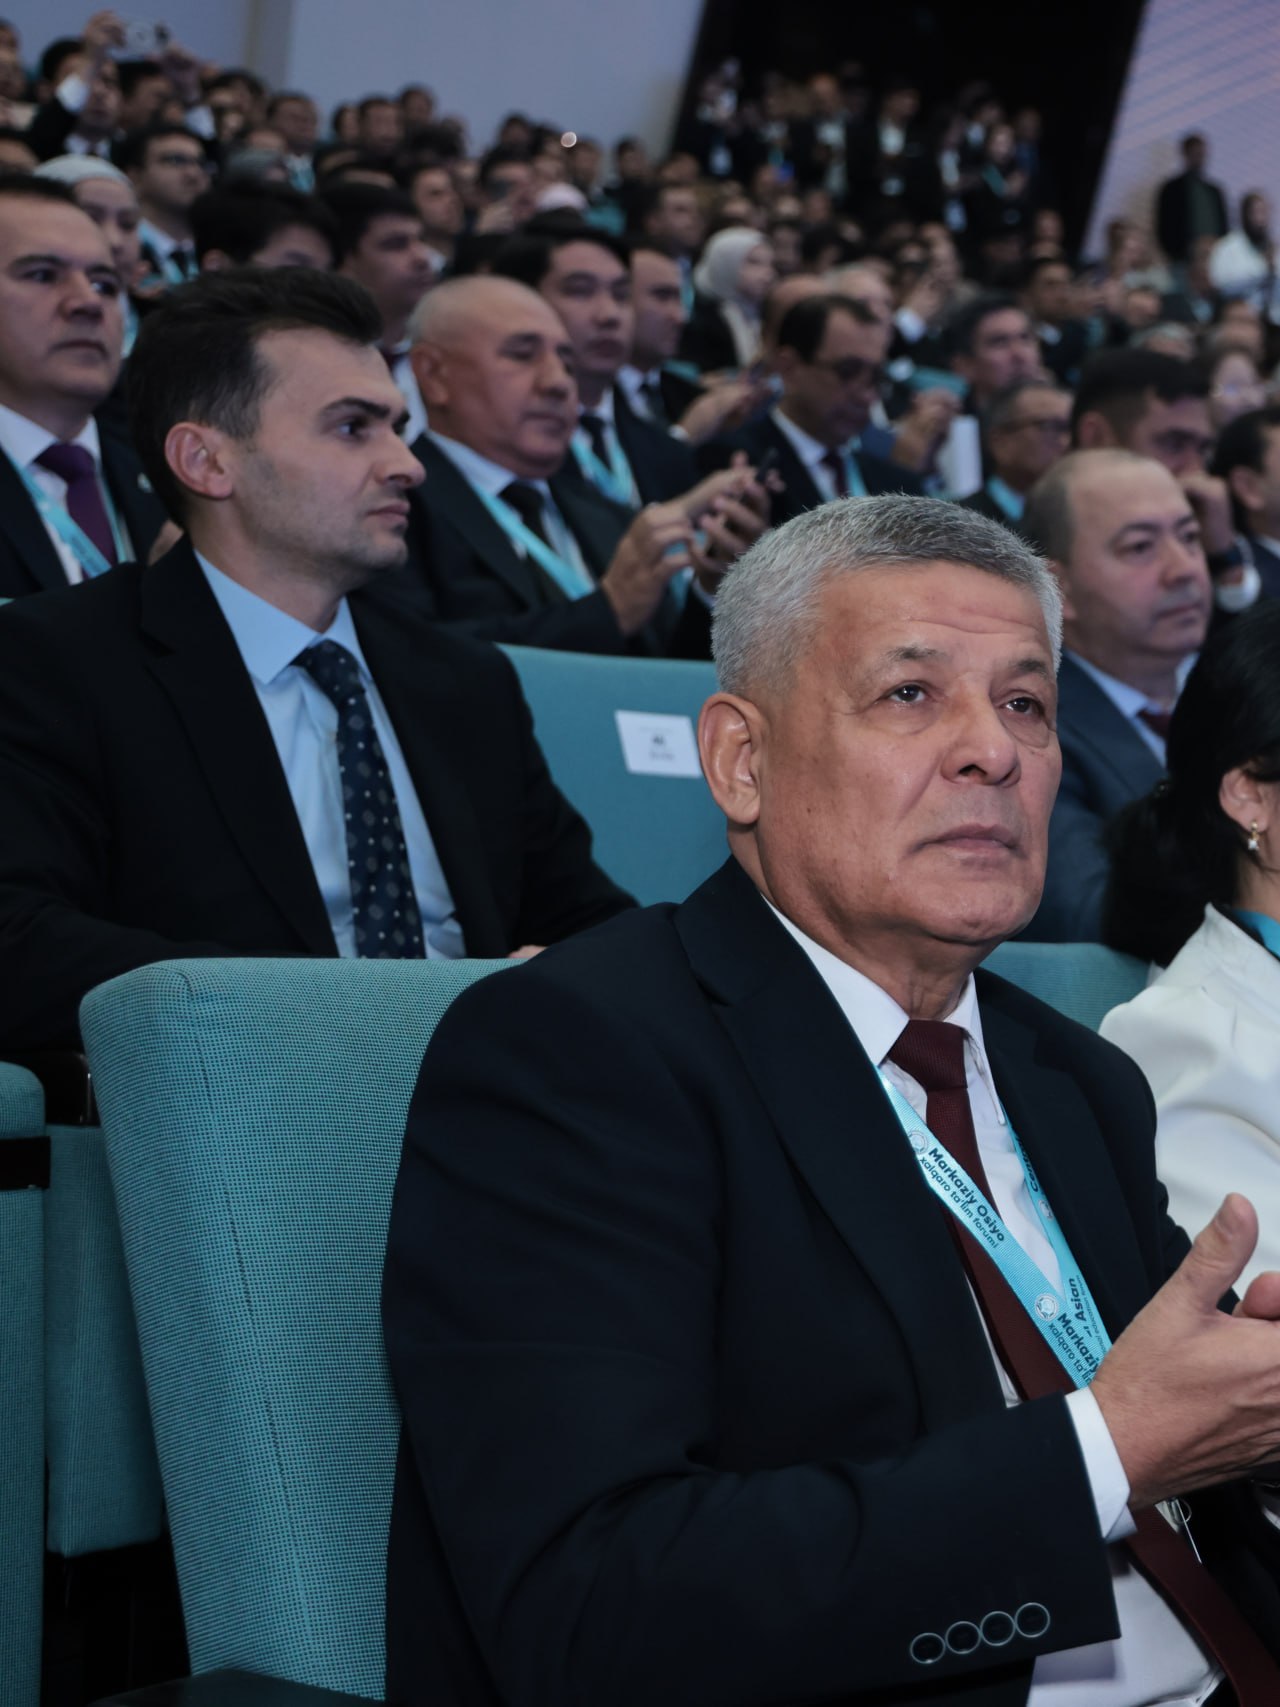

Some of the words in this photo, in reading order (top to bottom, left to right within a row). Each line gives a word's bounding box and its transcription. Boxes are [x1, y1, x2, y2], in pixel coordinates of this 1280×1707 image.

[920, 1157, 951, 1191] xalqaro
[973, 1217, 999, 1248] forumi
[928, 1148, 978, 1205] Markaziy
[977, 1205, 1005, 1241] Osiyo
[1069, 1278, 1087, 1321] Asian
[1048, 1323, 1075, 1360] xalqaro
